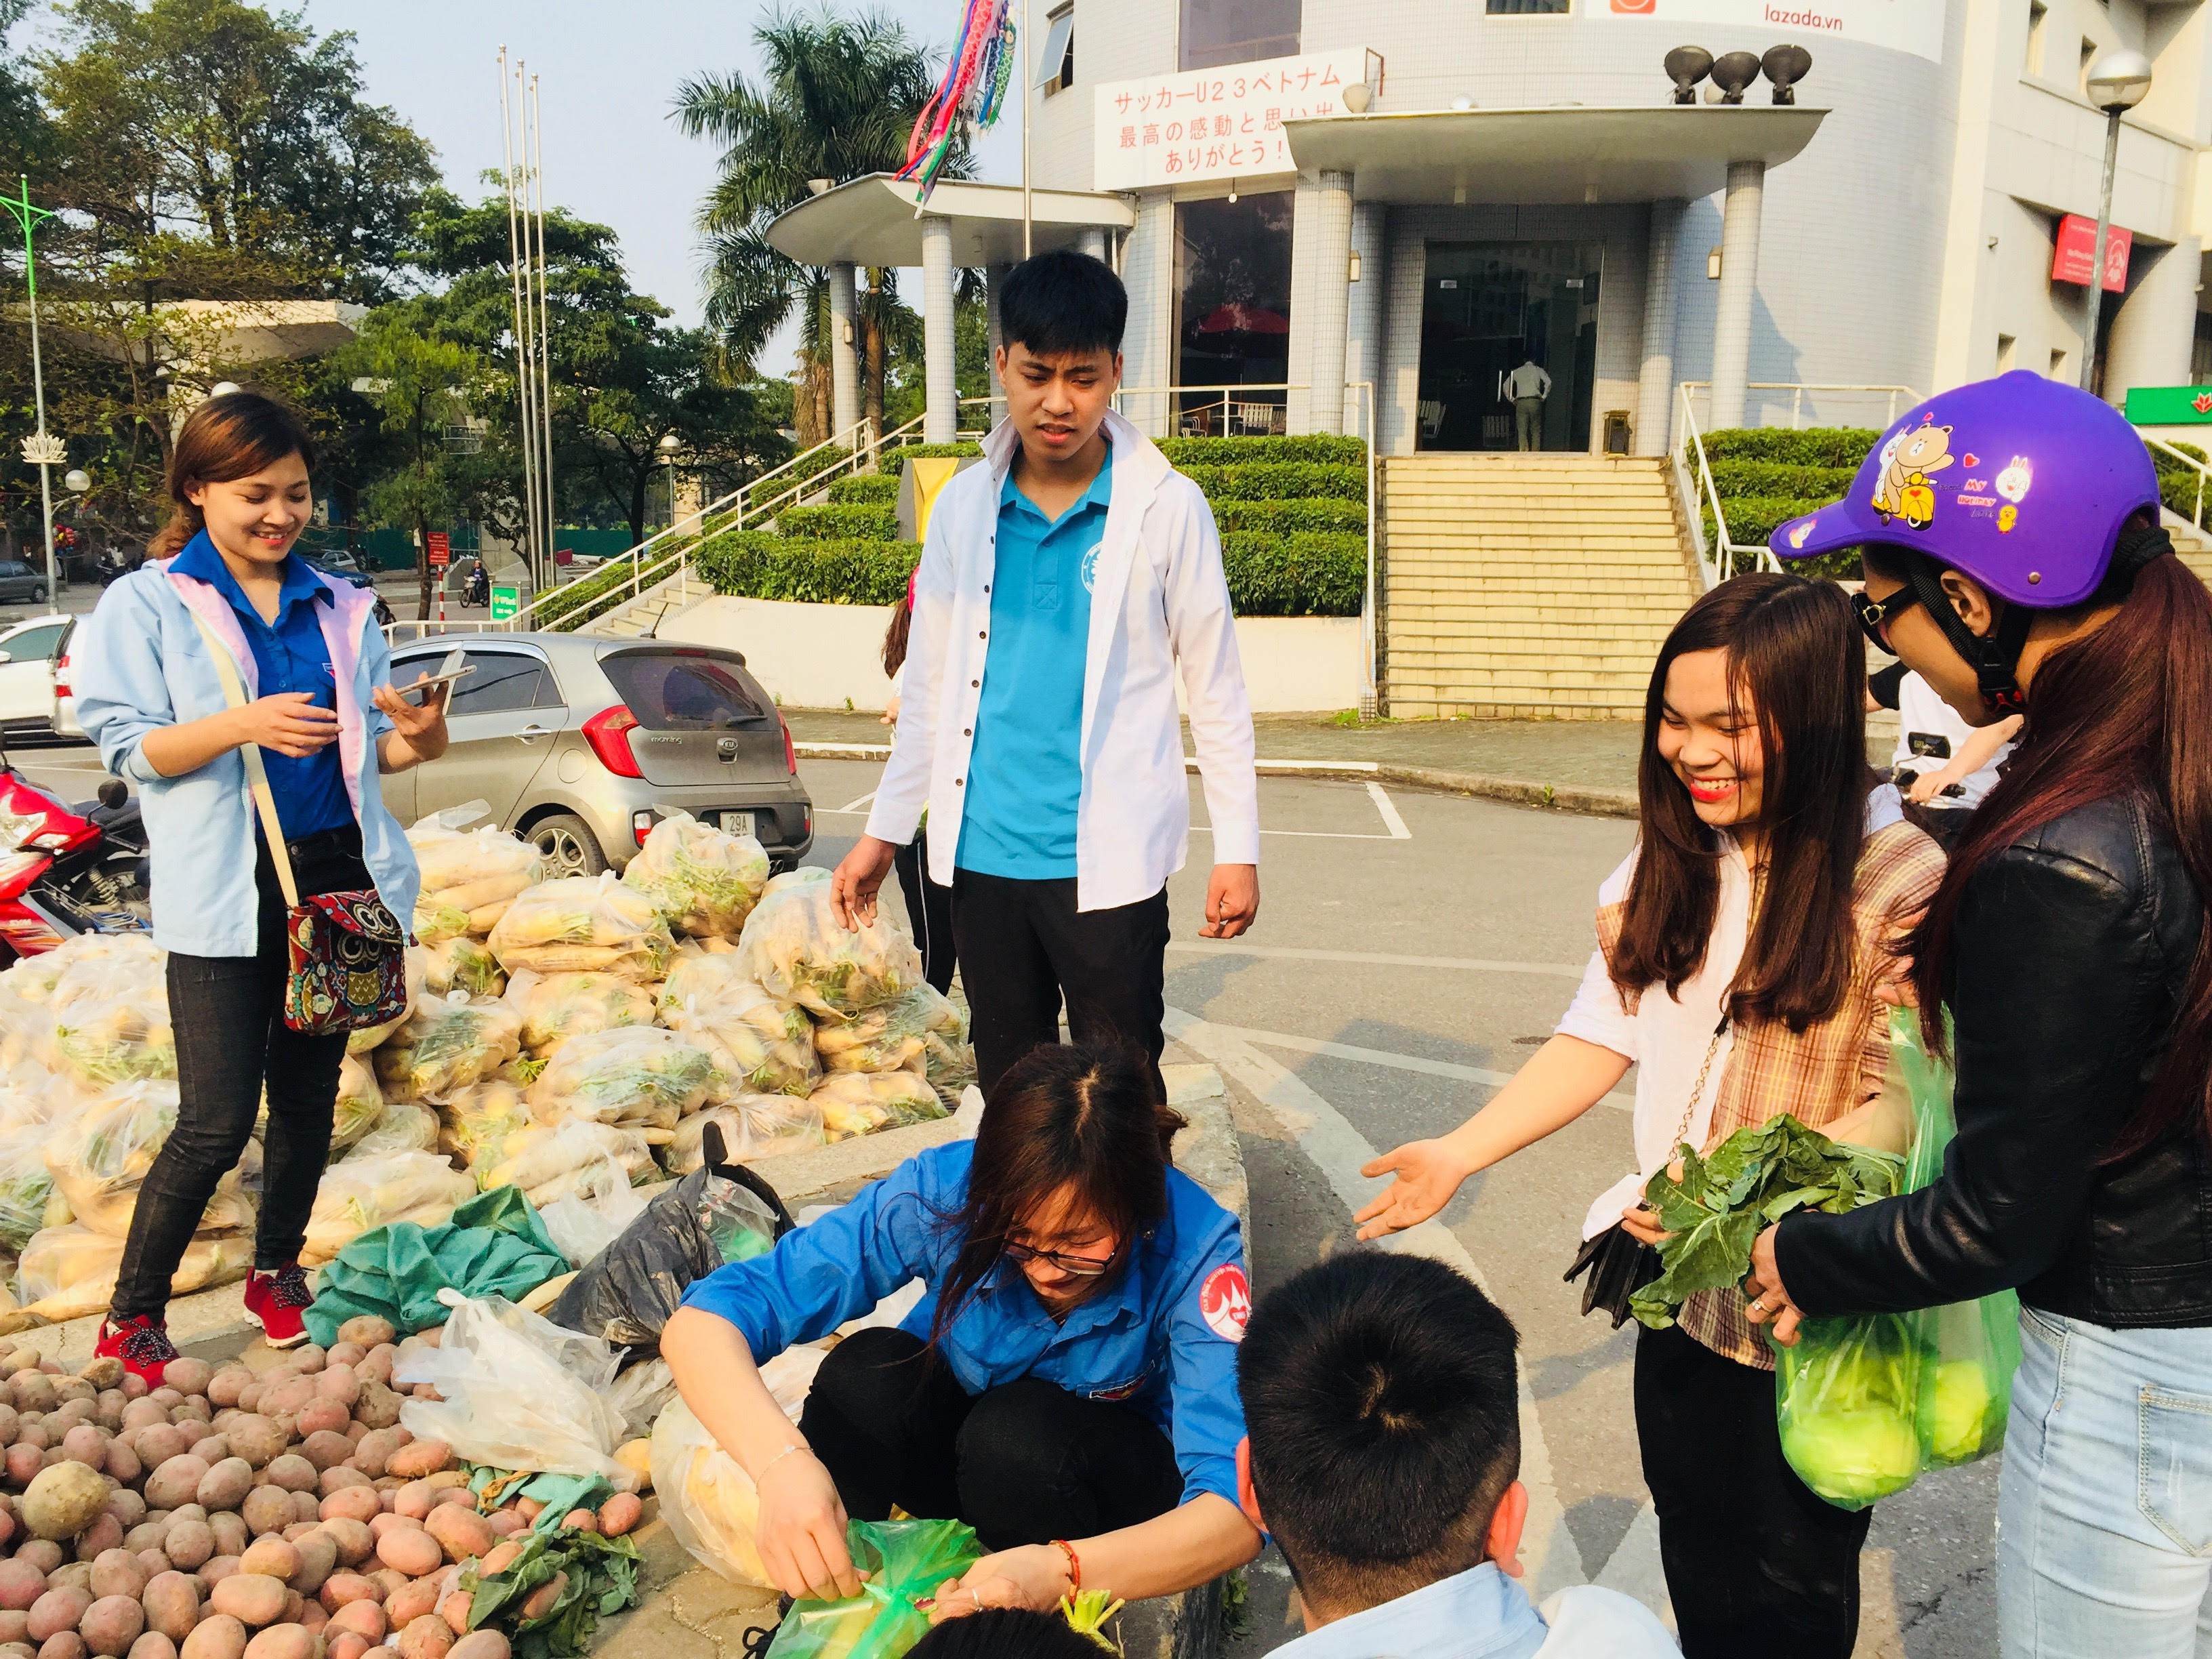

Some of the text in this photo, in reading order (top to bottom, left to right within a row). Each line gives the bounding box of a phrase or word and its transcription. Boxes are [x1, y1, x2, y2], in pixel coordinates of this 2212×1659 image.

[1765, 3, 1843, 30] lazada.vn
[1115, 64, 1340, 115] サッカーU23ベトナム
[729, 815, 747, 832] 29A
